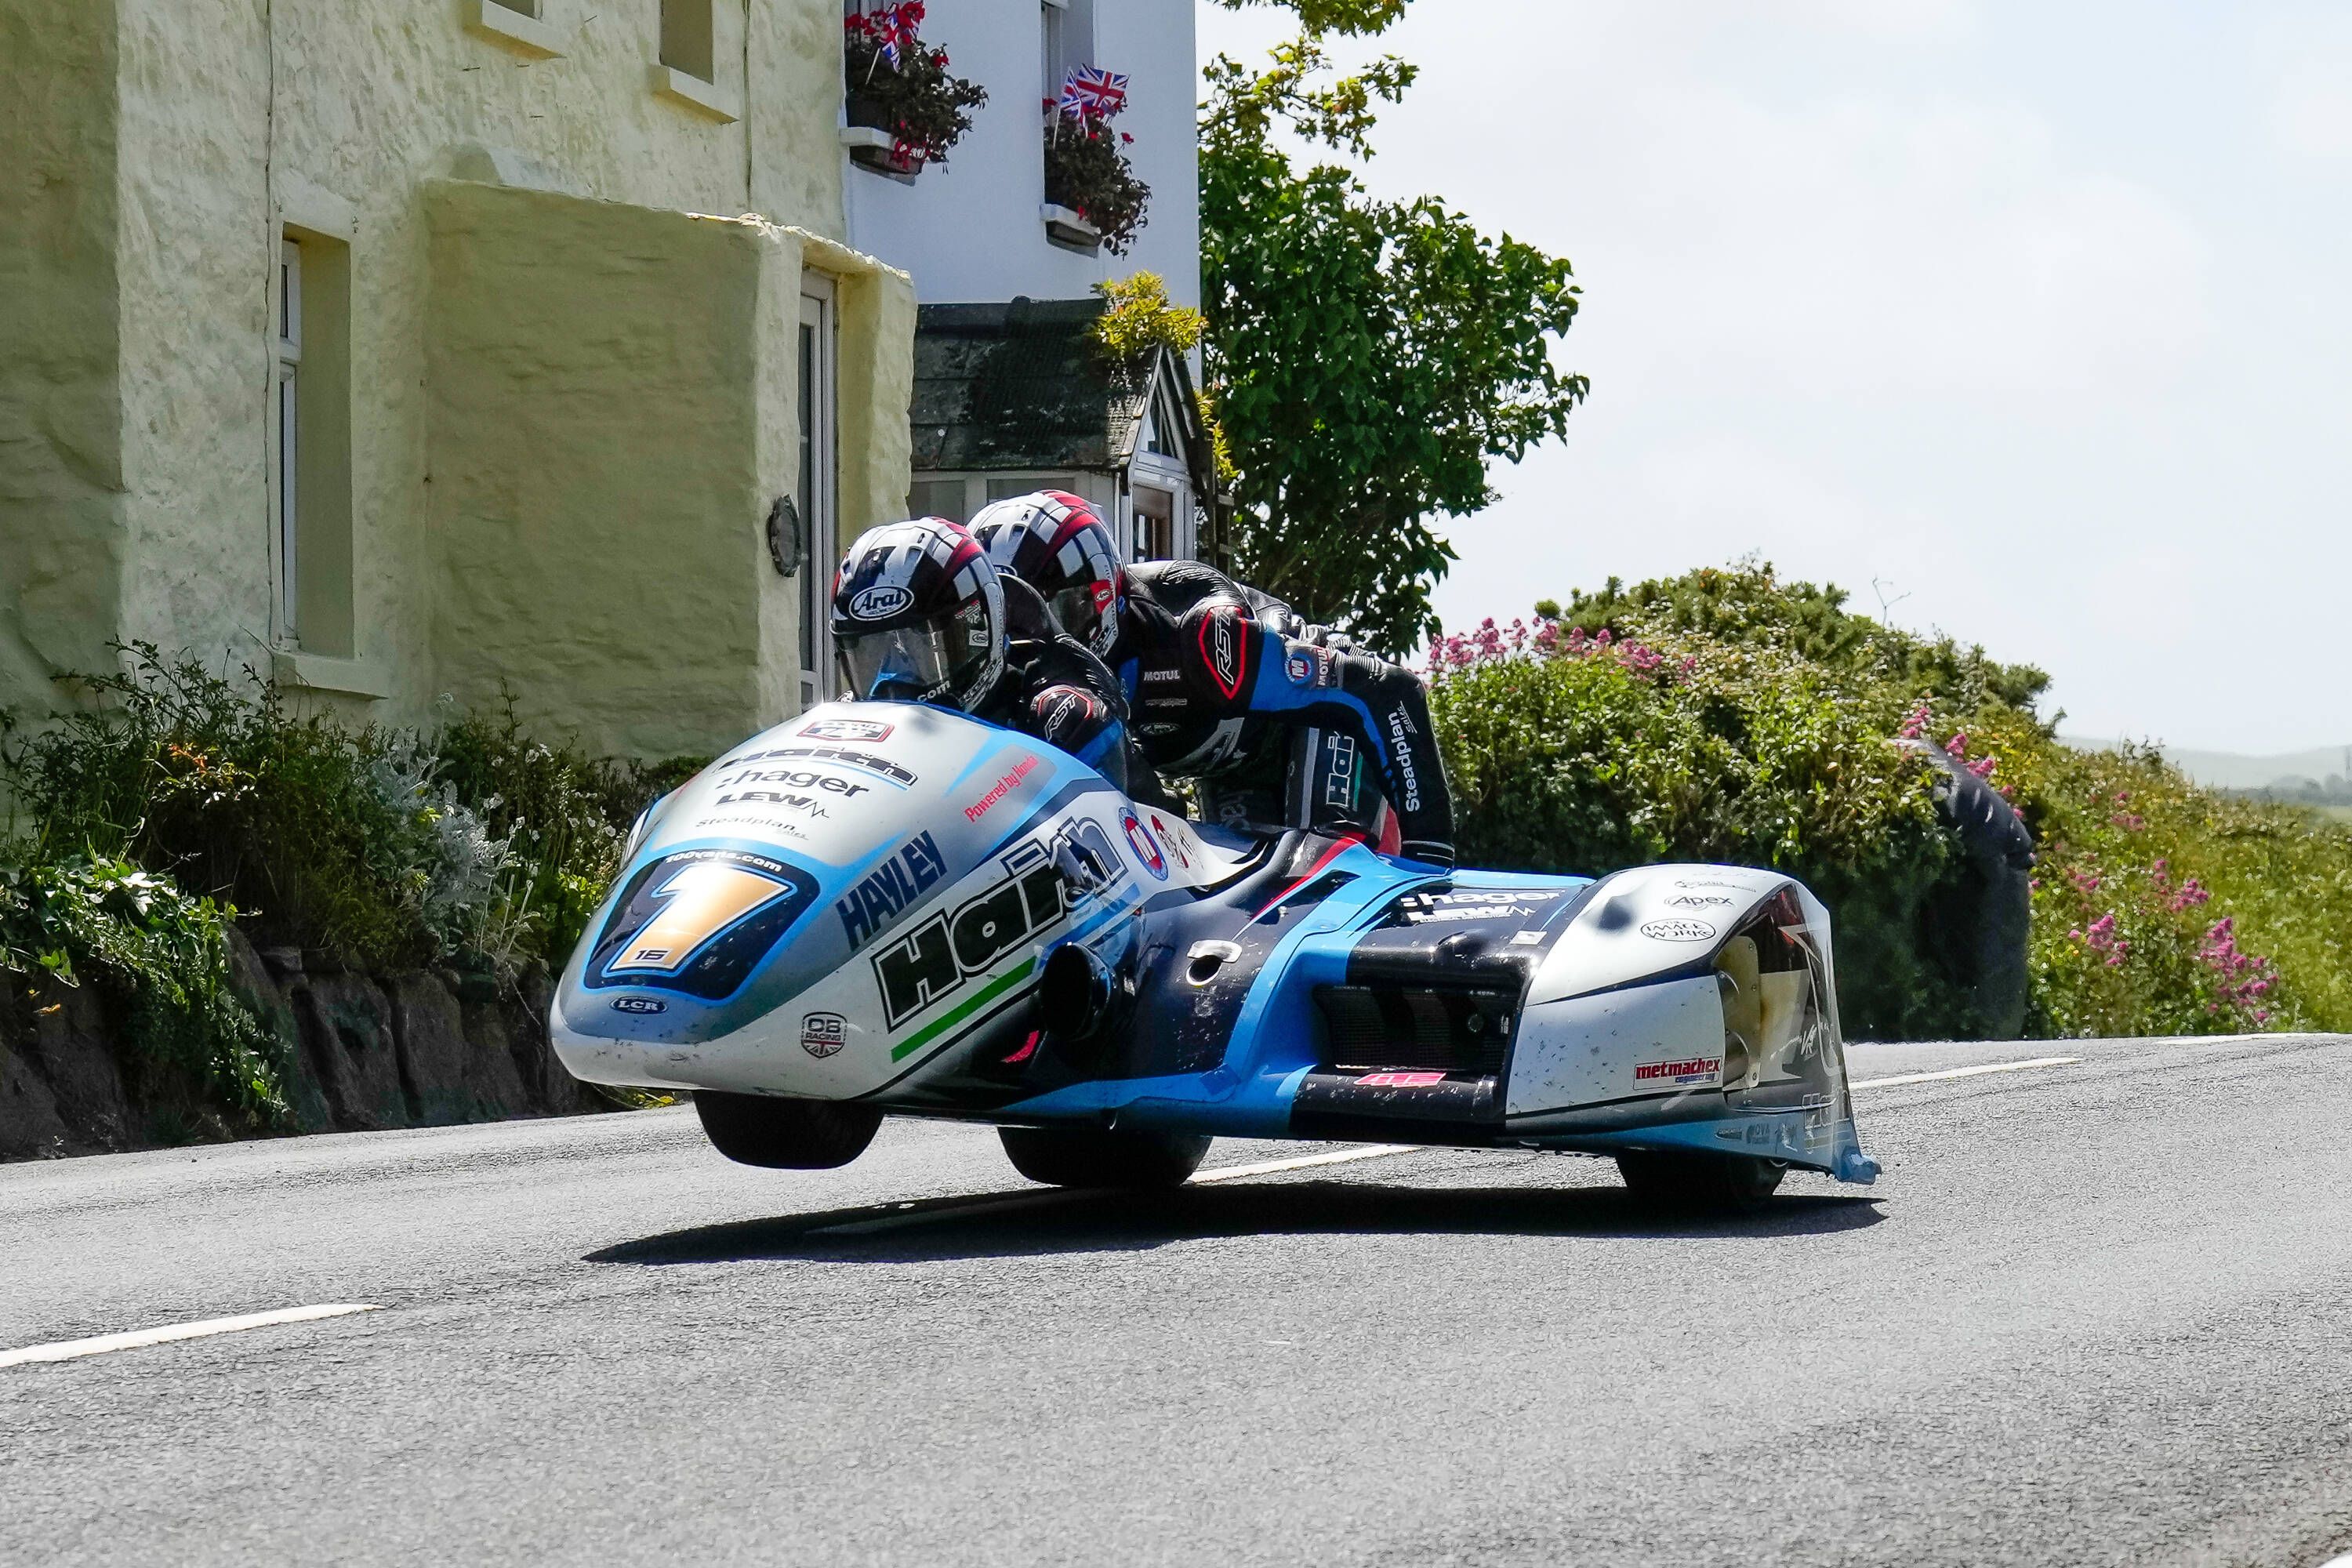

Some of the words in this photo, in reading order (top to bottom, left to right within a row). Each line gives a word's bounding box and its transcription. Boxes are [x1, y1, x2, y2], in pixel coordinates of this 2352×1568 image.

[857, 589, 904, 615] Arai
[1143, 670, 1181, 681] MOTUL
[1388, 711, 1421, 812] Steadplan
[964, 779, 1008, 822] Powered
[835, 829, 948, 952] HAYLEY
[1673, 896, 1734, 906] Apex
[608, 862, 792, 971] 1
[618, 1000, 659, 1011] LCR
[1636, 1058, 1720, 1079] metmachex
